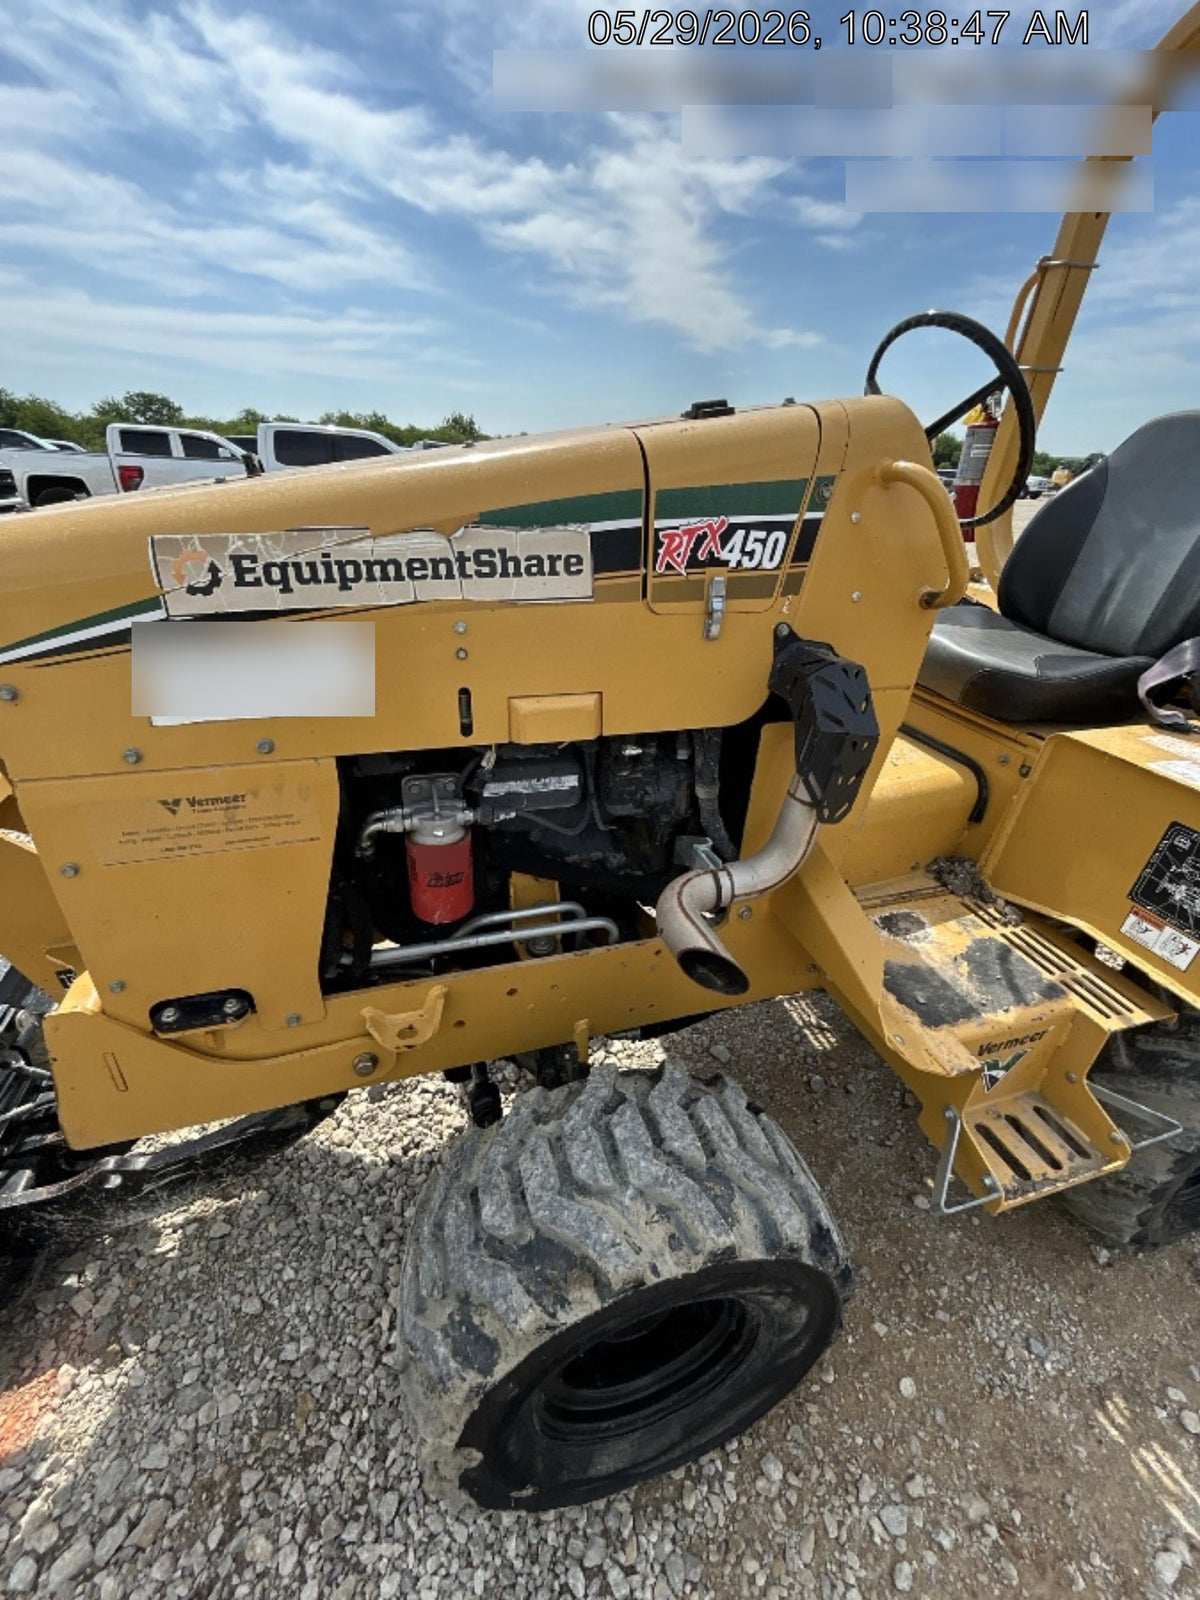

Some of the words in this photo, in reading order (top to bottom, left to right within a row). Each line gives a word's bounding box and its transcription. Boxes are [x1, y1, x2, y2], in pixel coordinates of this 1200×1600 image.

[228, 547, 585, 595] EquipmentShare
[186, 792, 248, 808] Vermeer
[977, 1029, 1049, 1057] Vermeer
